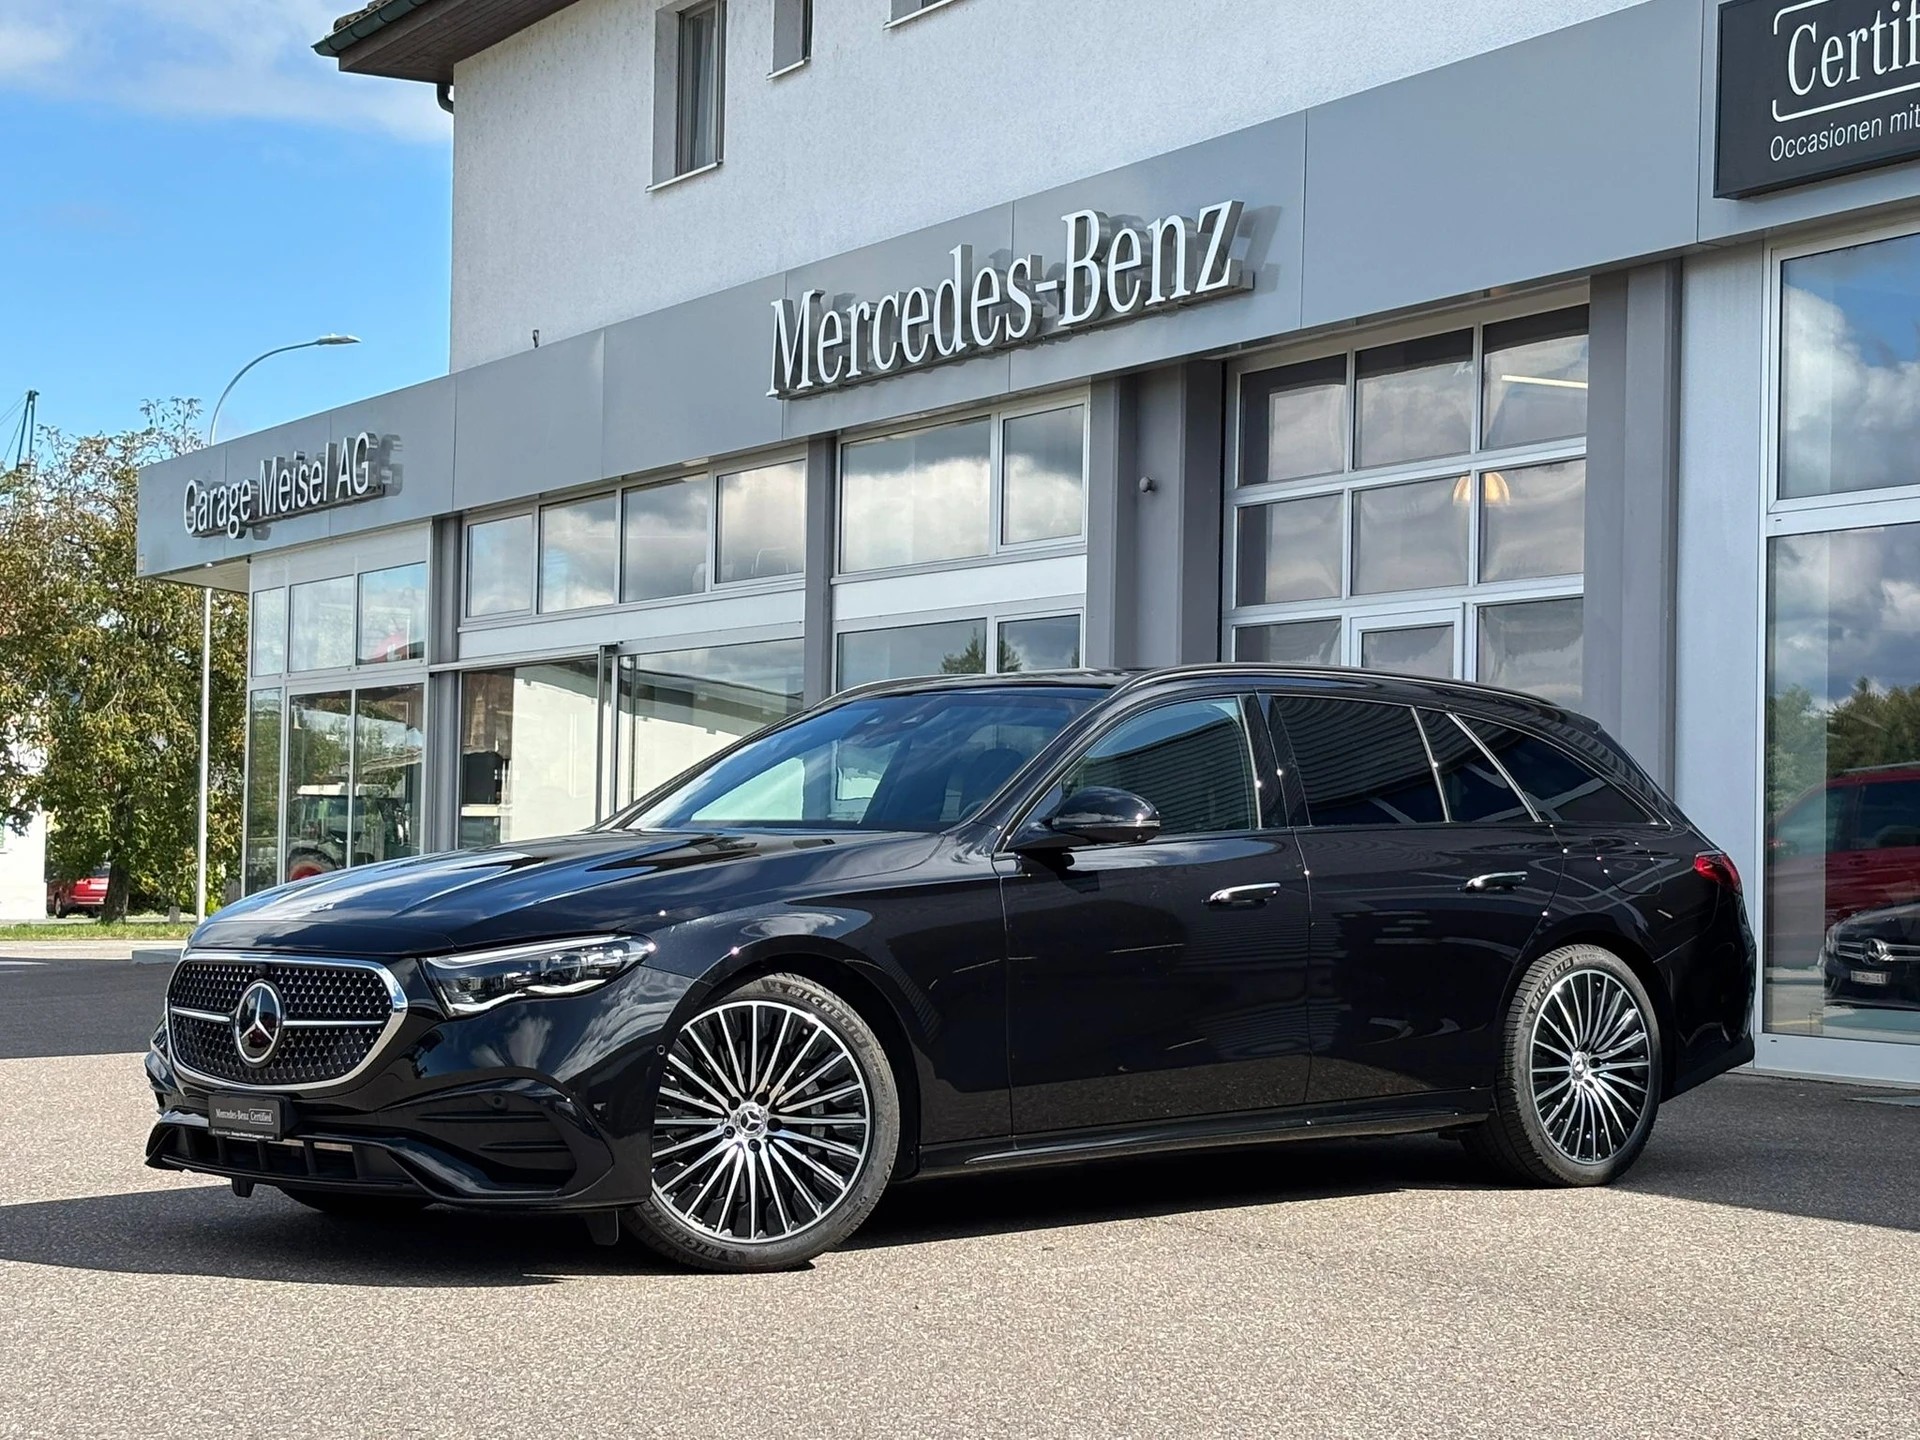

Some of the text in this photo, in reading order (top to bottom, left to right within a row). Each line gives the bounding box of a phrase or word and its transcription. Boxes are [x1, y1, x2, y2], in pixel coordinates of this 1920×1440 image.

[1770, 103, 1920, 161] Occasionen mit
[766, 200, 1245, 397] Mercedes-Benz
[184, 432, 370, 539] Garage Meisel AG
[1531, 957, 1572, 1011] MICHELIN
[787, 985, 866, 1045] MICHELIN
[250, 1111, 272, 1122] Certified
